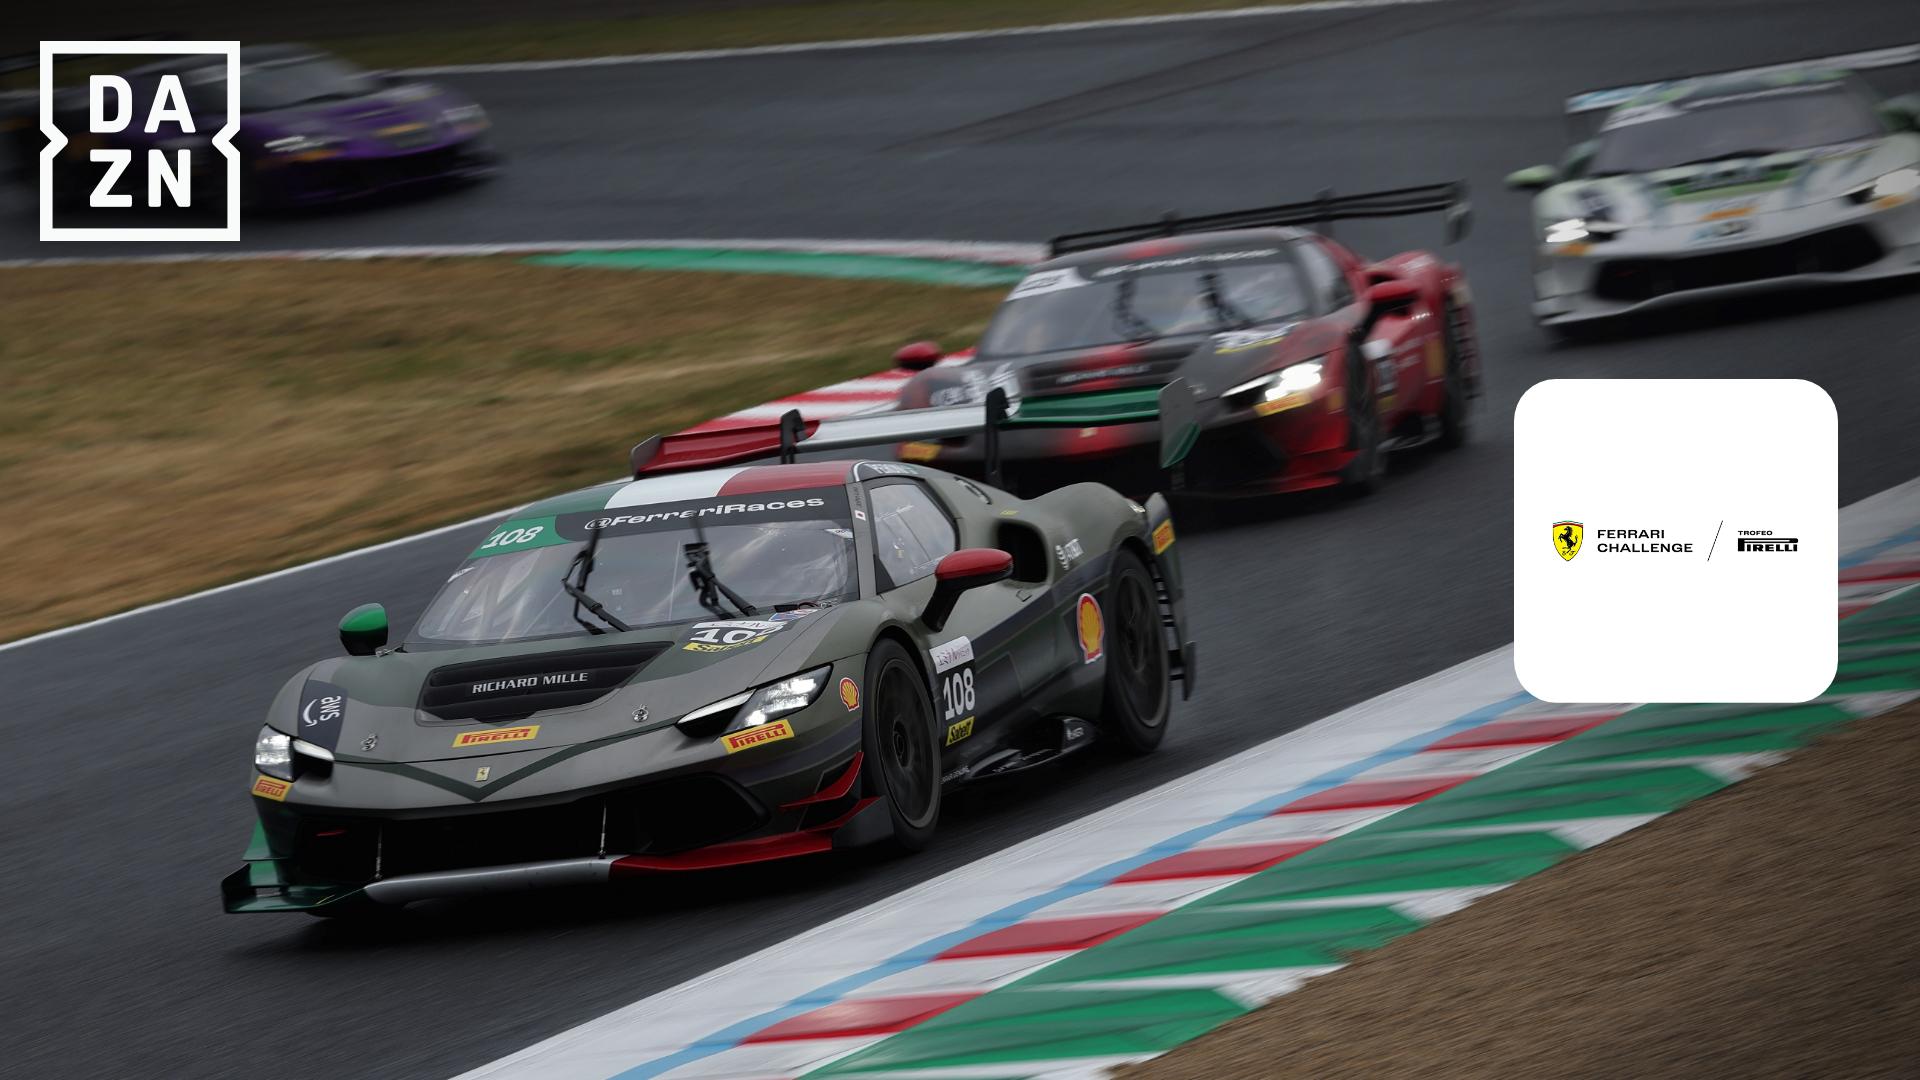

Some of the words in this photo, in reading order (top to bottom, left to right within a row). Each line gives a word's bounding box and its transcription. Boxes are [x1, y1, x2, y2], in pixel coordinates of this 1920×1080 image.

[583, 497, 825, 530] @FerrariRaces
[480, 525, 544, 550] 108
[471, 676, 538, 694] RICHARD
[542, 672, 589, 686] MILLE
[942, 667, 976, 721] 108
[319, 695, 342, 722] aws
[460, 728, 532, 745] PIRELLI
[728, 723, 788, 749] PIRELLI
